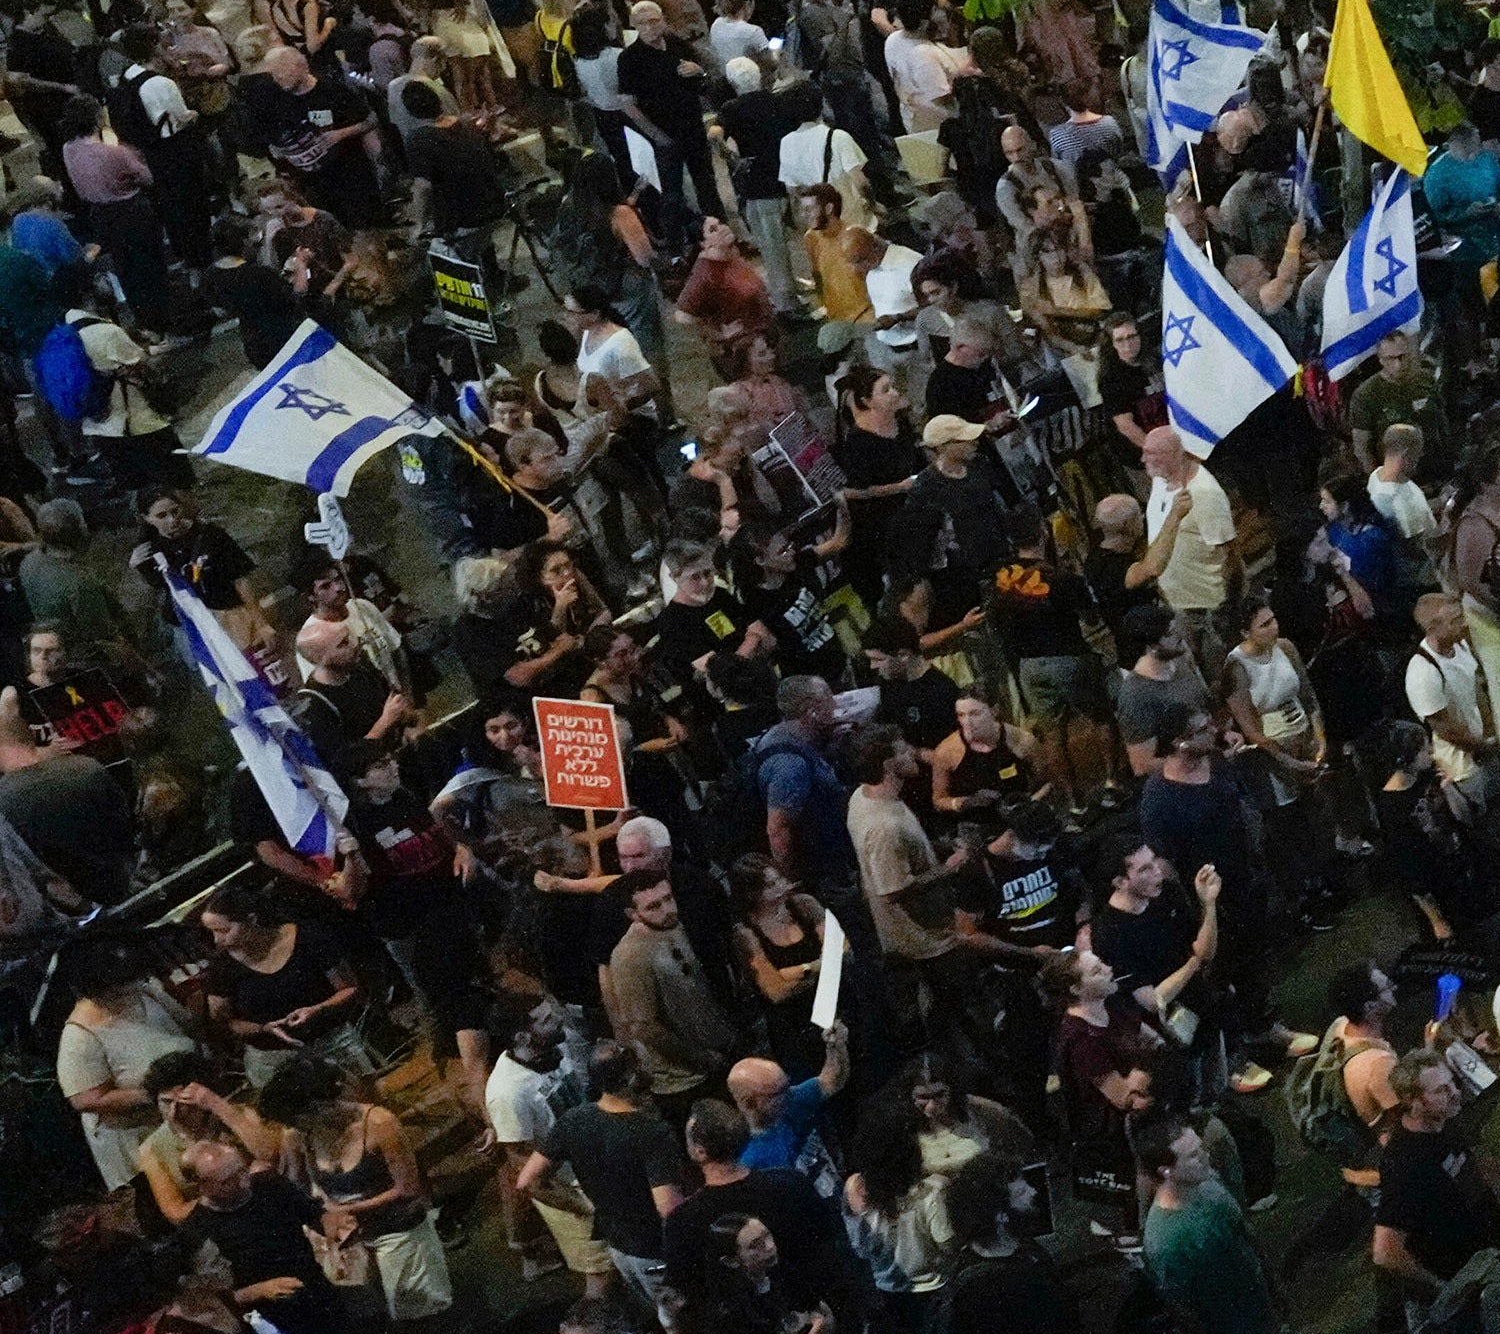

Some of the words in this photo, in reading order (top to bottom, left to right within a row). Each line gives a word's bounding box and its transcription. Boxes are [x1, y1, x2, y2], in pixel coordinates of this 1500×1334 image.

[54, 699, 126, 745] HELP
[546, 712, 604, 731] דורשים
[547, 727, 609, 746] מנהיגות
[554, 743, 606, 761] ערכית
[565, 755, 598, 772] ללא
[556, 770, 612, 789] פשרות
